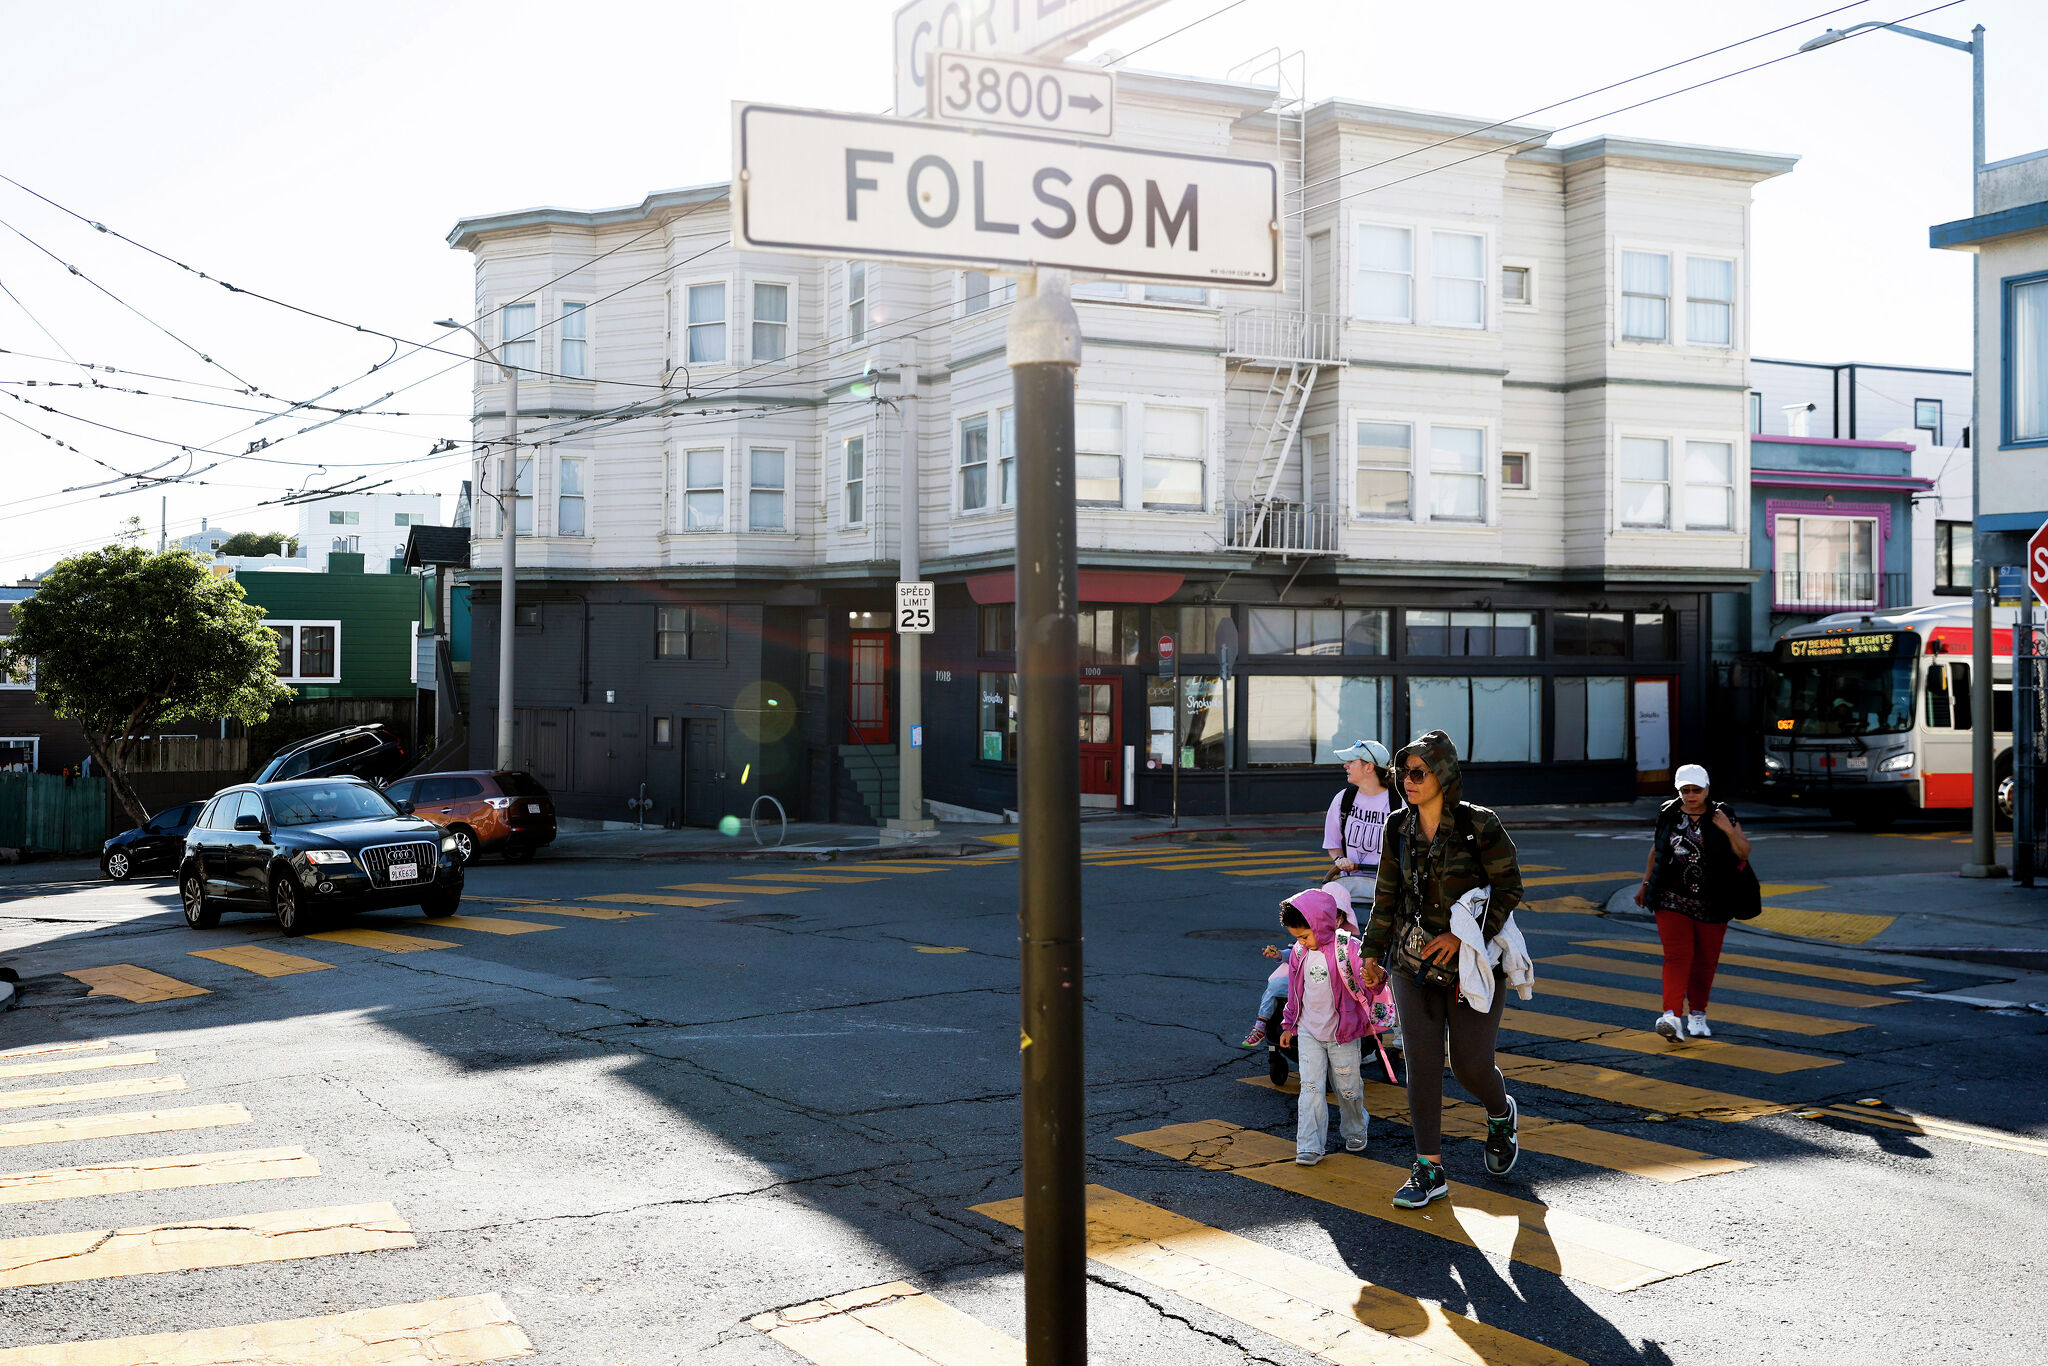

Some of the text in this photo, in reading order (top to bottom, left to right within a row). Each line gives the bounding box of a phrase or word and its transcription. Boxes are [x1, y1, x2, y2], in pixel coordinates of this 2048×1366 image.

[945, 63, 1062, 122] 3800
[845, 147, 1199, 252] FOLSOM
[2000, 566, 2011, 576] 67
[900, 588, 930, 596] SPEED
[903, 598, 928, 606] LIMIT
[901, 609, 930, 628] 25
[1808, 634, 1894, 649] BERNAL HEIGHTS
[1791, 641, 1808, 657] 67
[935, 670, 952, 681] 1018
[1085, 667, 1101, 676] 1000
